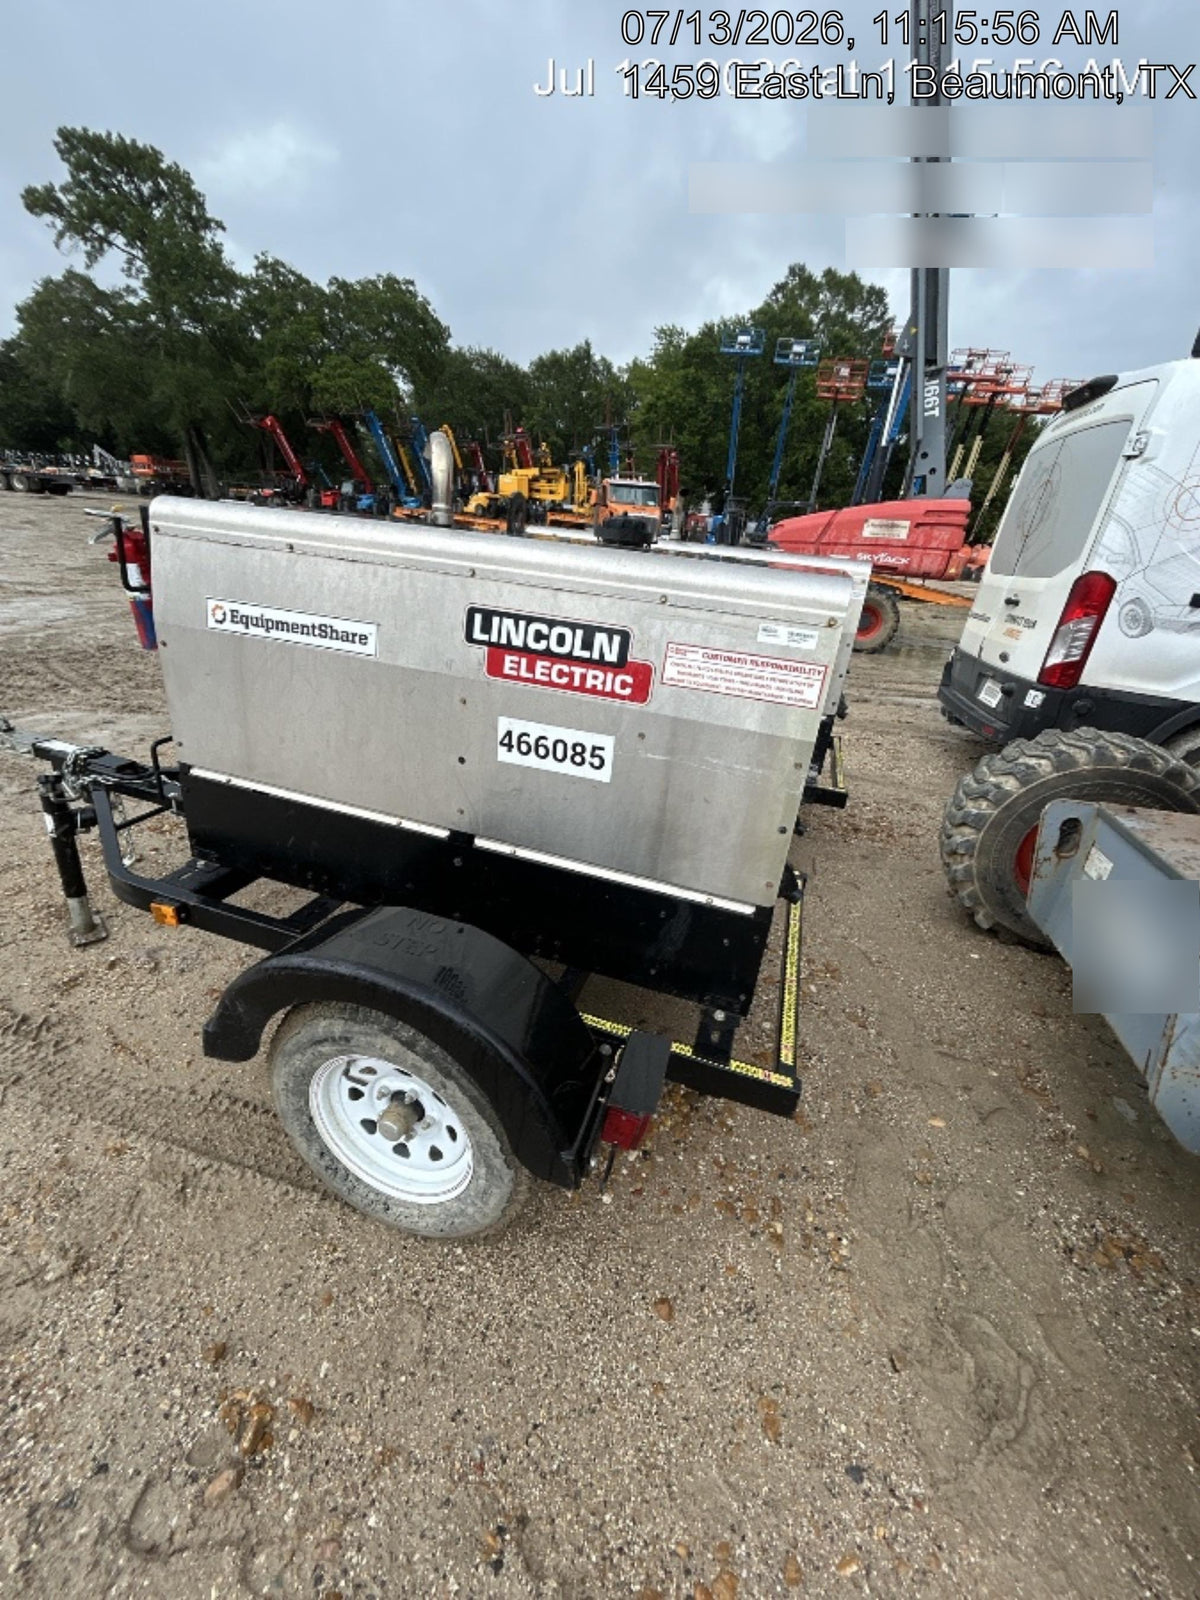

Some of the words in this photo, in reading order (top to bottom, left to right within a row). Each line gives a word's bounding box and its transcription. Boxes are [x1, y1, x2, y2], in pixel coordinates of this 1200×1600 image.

[856, 552, 911, 565] SKYJACK
[229, 609, 369, 646] EquipmentShare
[471, 612, 622, 664] LINCOLN
[502, 653, 634, 697] ELECTRIC
[499, 729, 607, 771] 466085
